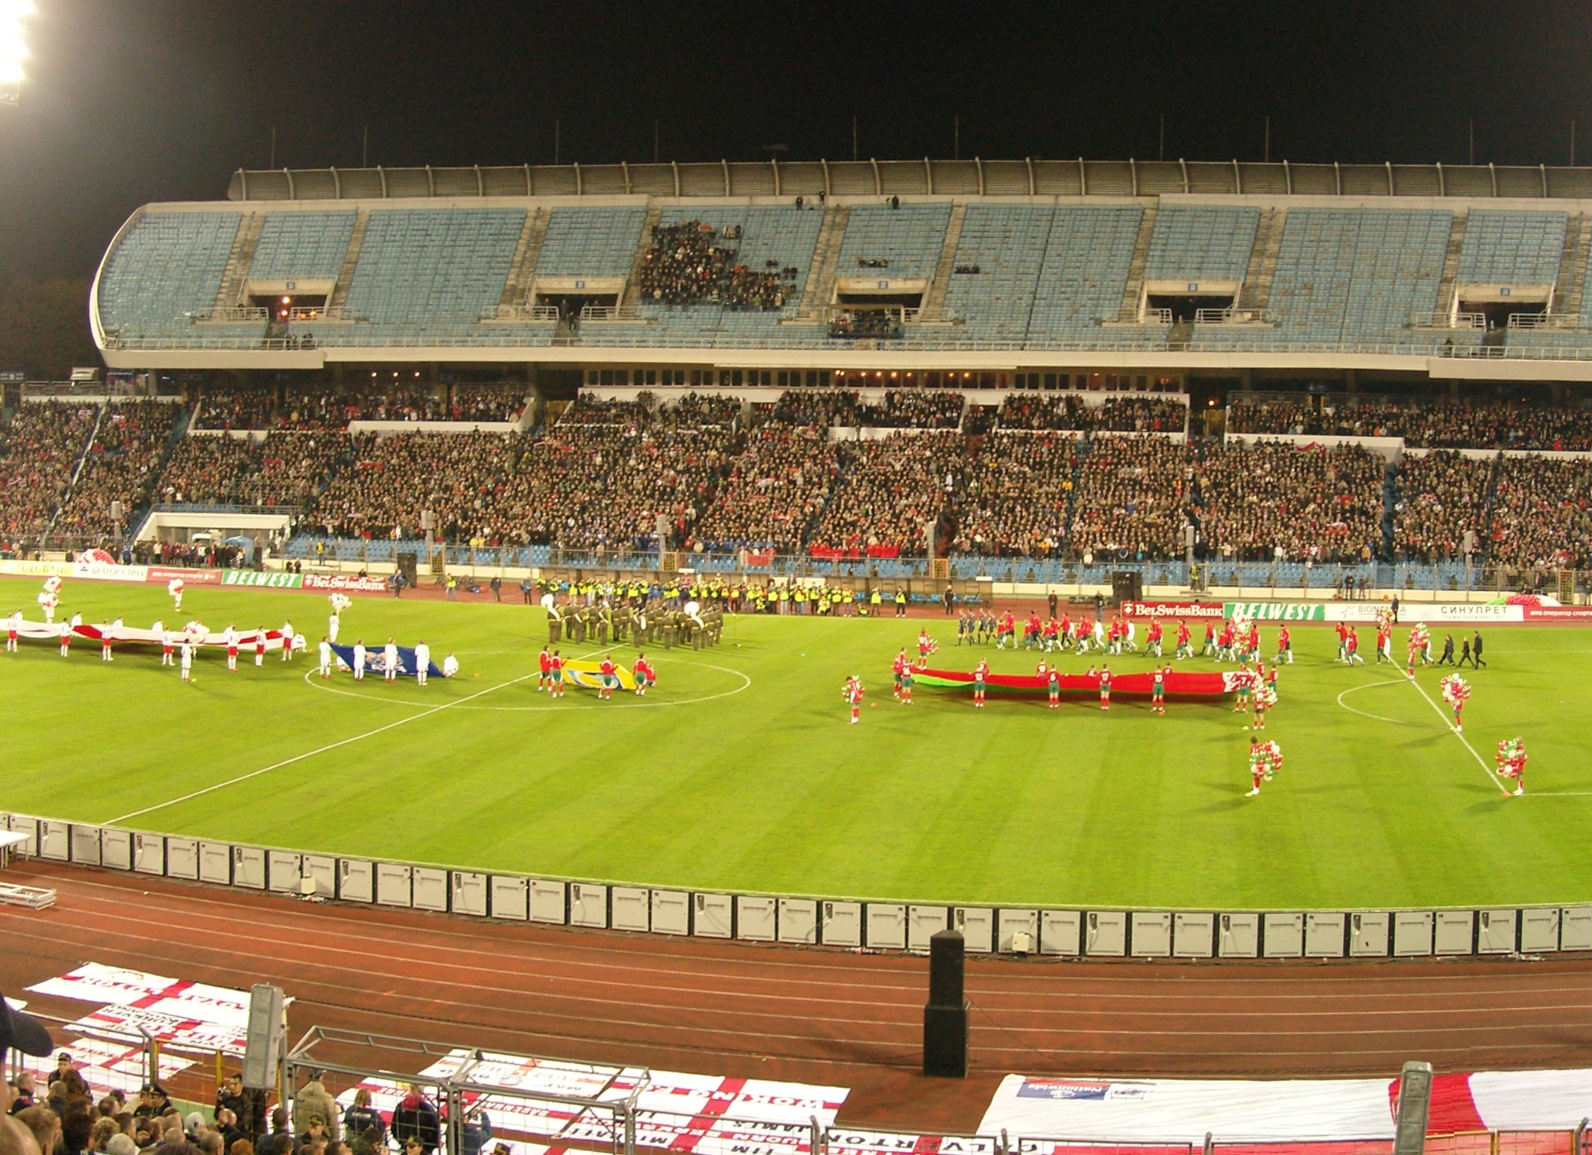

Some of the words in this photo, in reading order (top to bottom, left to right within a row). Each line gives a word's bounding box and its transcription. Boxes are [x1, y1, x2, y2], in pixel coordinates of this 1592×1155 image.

[227, 571, 297, 587] BELWEST
[1233, 603, 1322, 620] BELWEST
[1441, 606, 1507, 614] СИНУПРЕТ
[1028, 1083, 1103, 1093] Nationwide
[687, 1088, 824, 1109] WOKING
[731, 1144, 774, 1155] TIM
